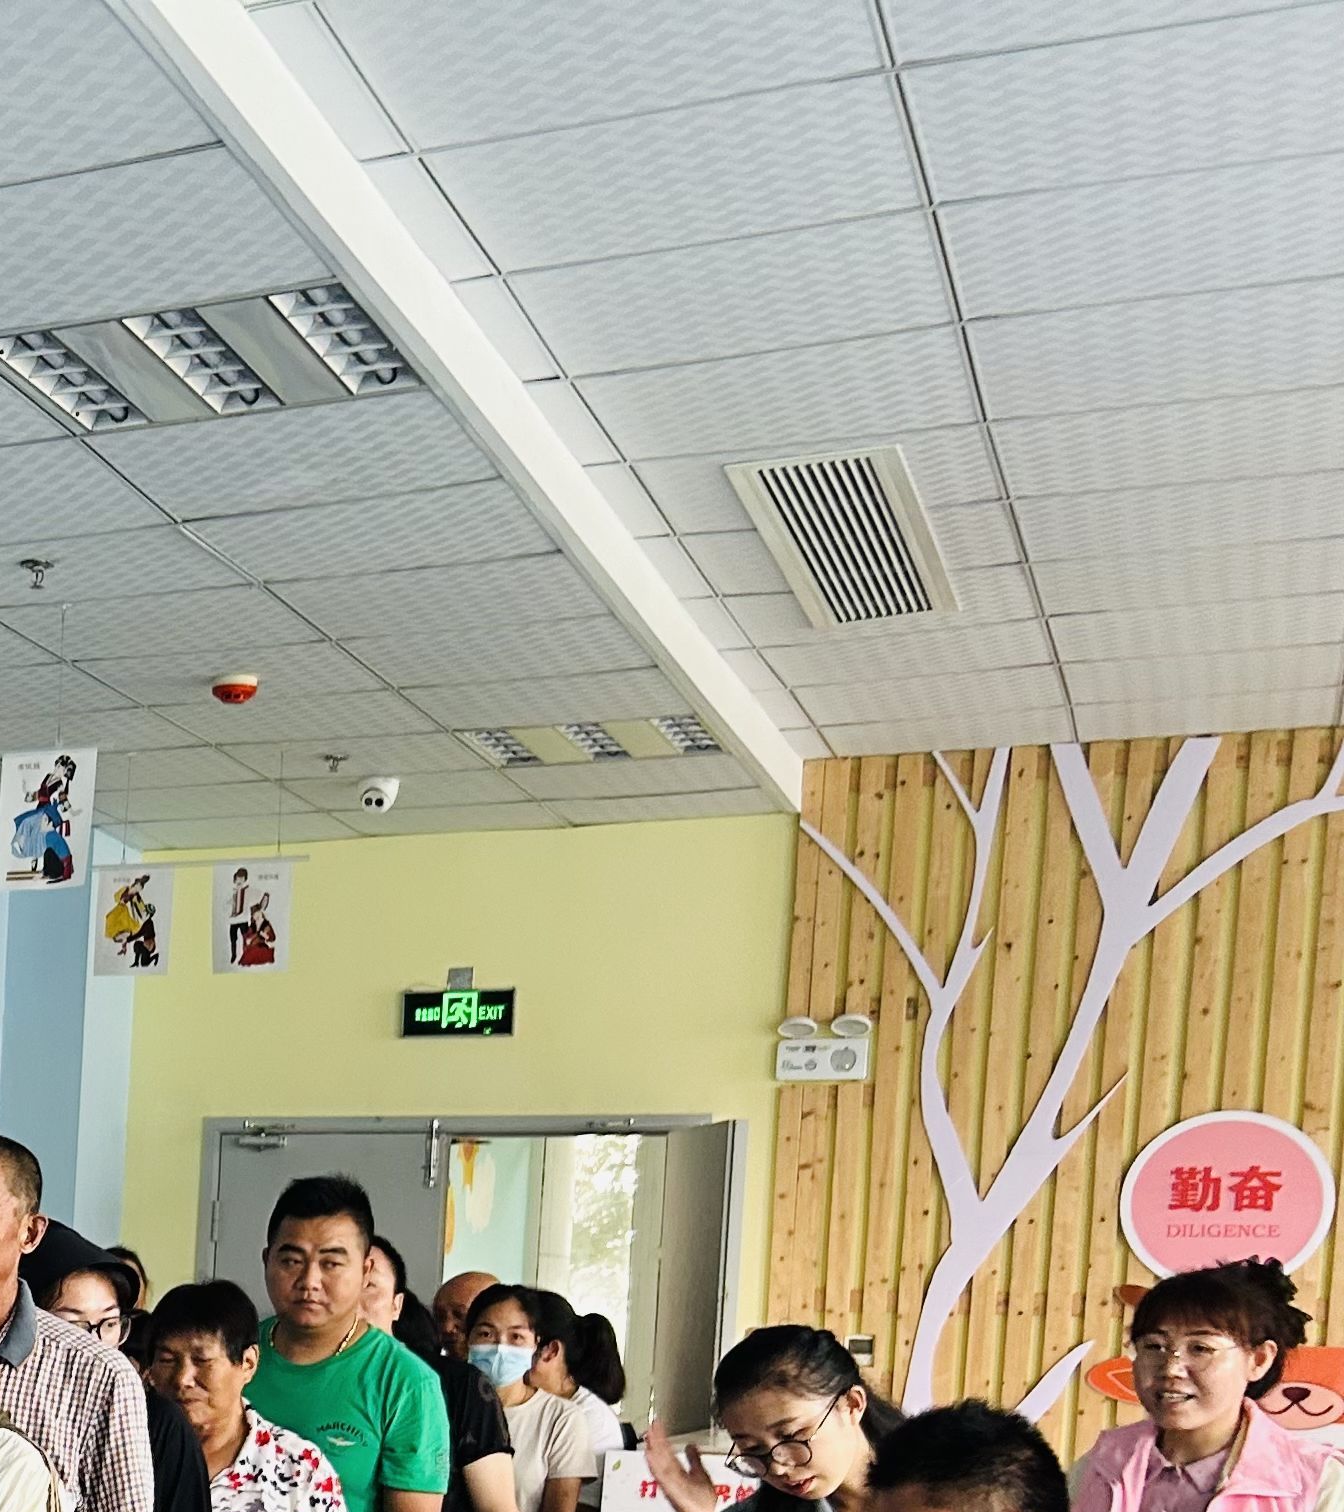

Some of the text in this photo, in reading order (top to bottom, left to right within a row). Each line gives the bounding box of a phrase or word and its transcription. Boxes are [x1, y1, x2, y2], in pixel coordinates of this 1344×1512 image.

[478, 1005, 505, 1020] EXIT
[1168, 1165, 1282, 1212] 勤奋
[1167, 1223, 1280, 1238] DILIGENCE
